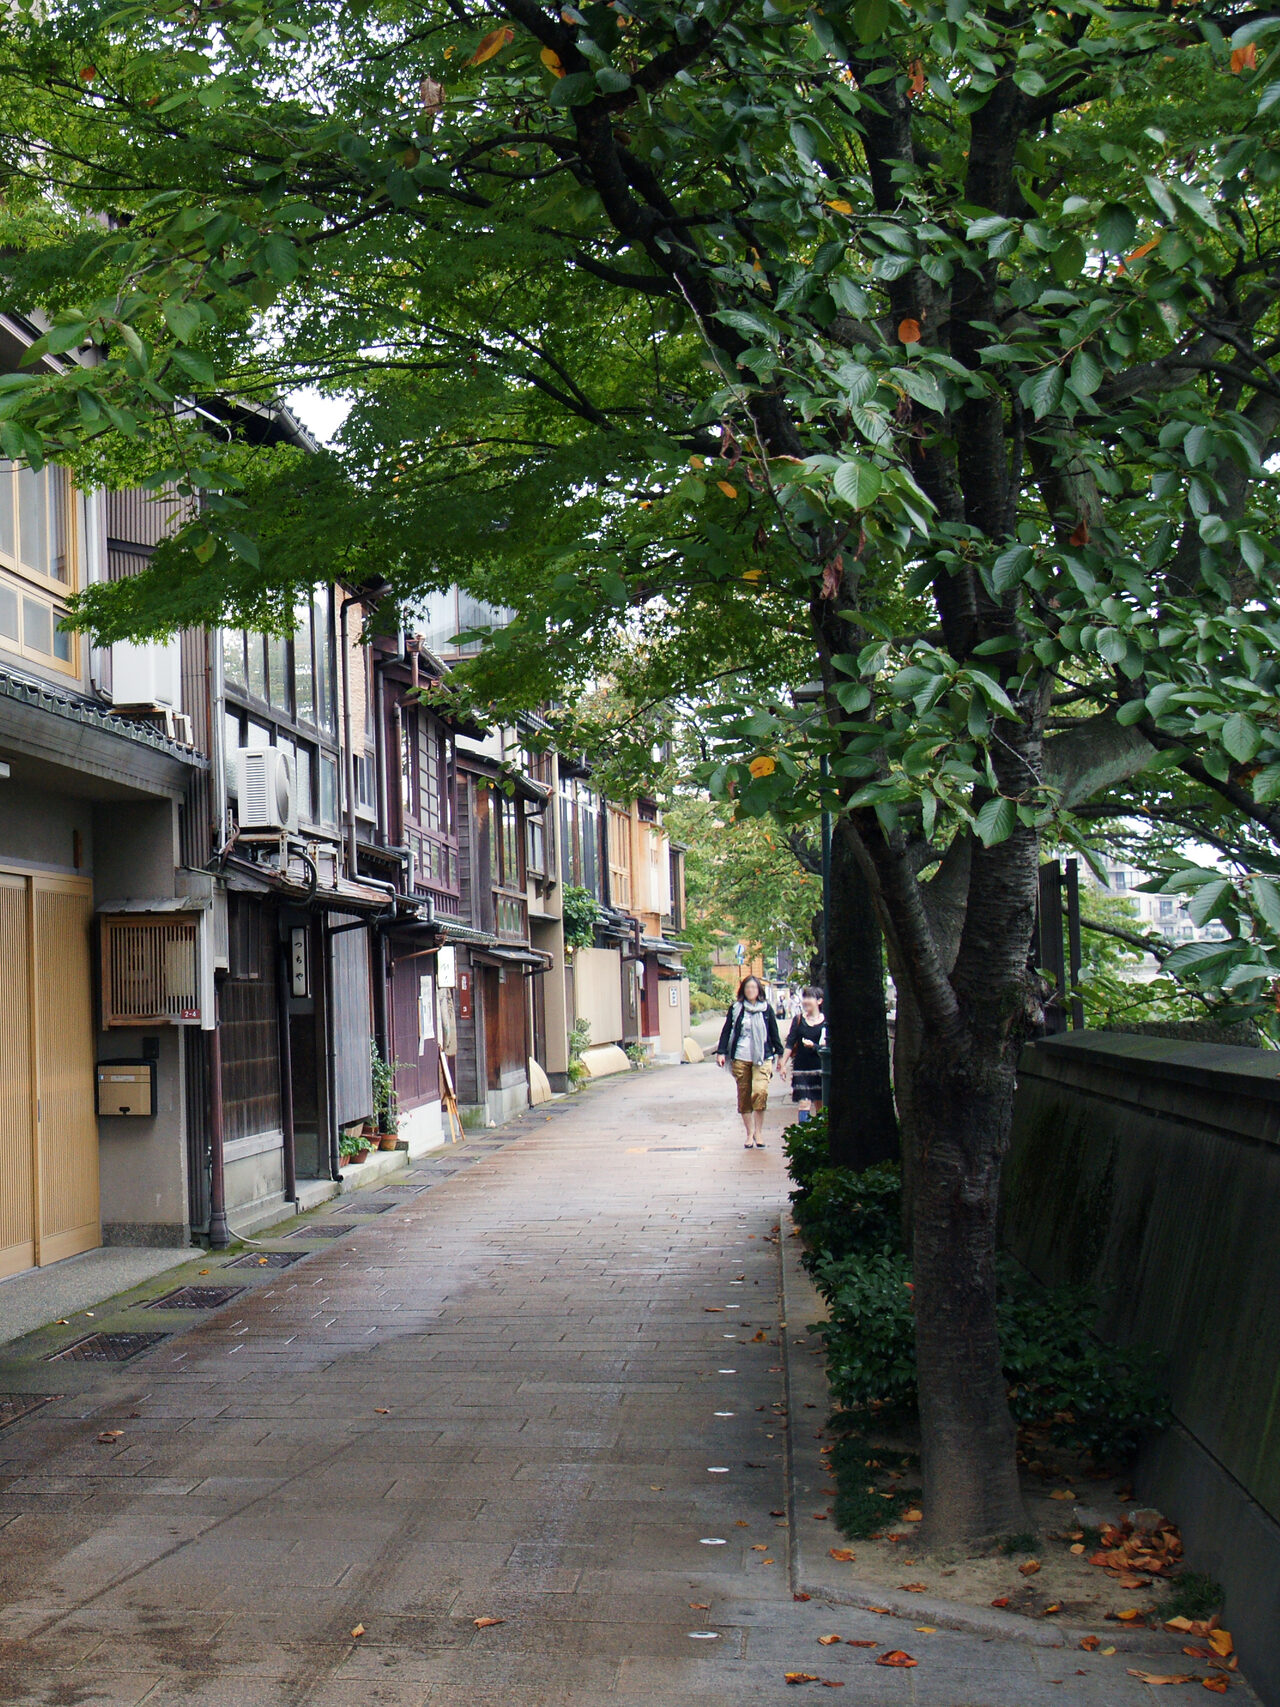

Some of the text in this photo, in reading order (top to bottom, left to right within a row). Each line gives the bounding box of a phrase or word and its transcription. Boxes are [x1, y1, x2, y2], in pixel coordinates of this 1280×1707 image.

[294, 942, 304, 981] つちや
[184, 1010, 197, 1018] 2-4
